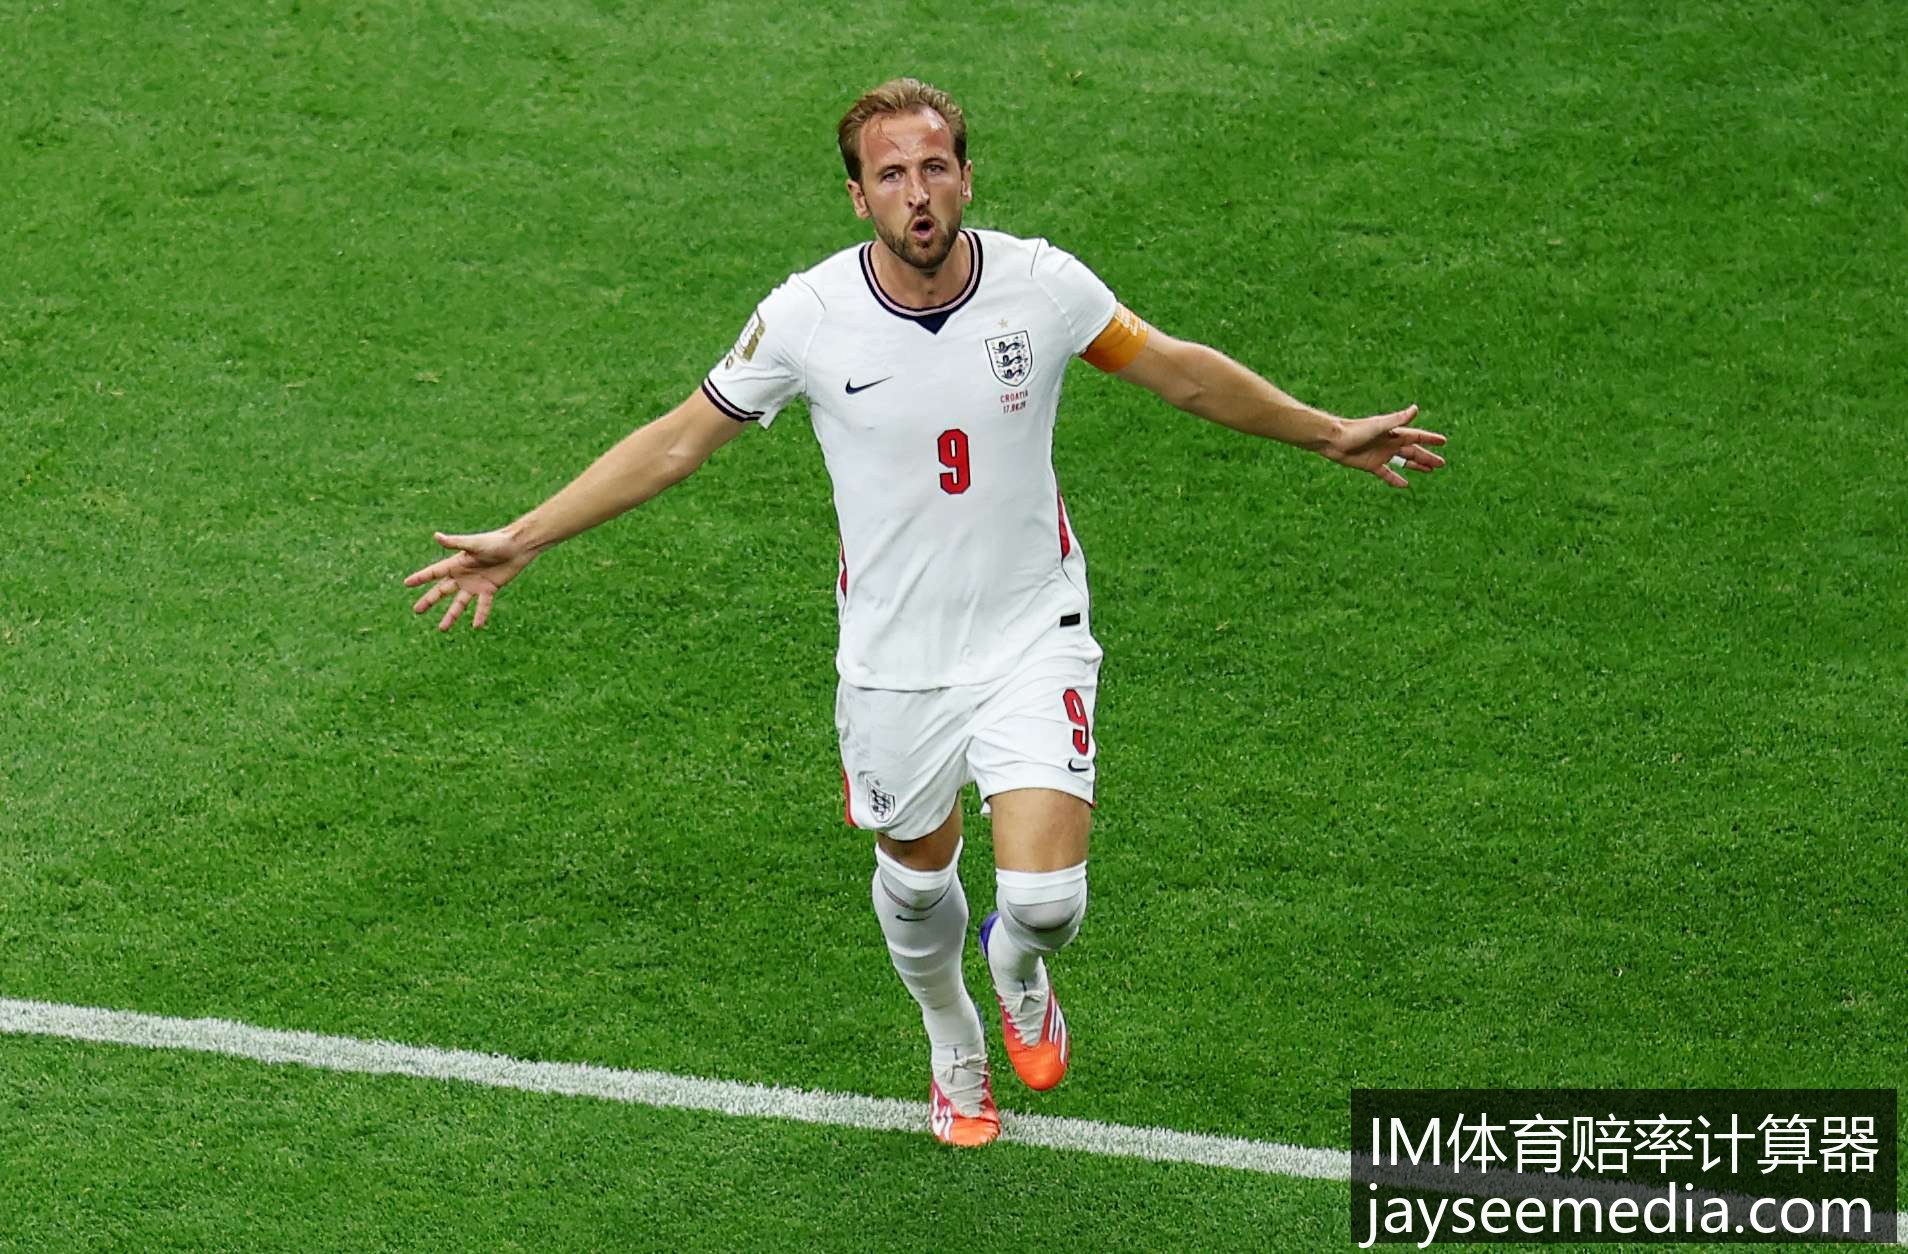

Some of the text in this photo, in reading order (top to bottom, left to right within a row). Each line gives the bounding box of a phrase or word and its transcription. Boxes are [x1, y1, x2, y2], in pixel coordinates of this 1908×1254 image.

[1000, 390, 1029, 403] CROATIA
[937, 428, 971, 495] 9
[1063, 688, 1089, 756] 9
